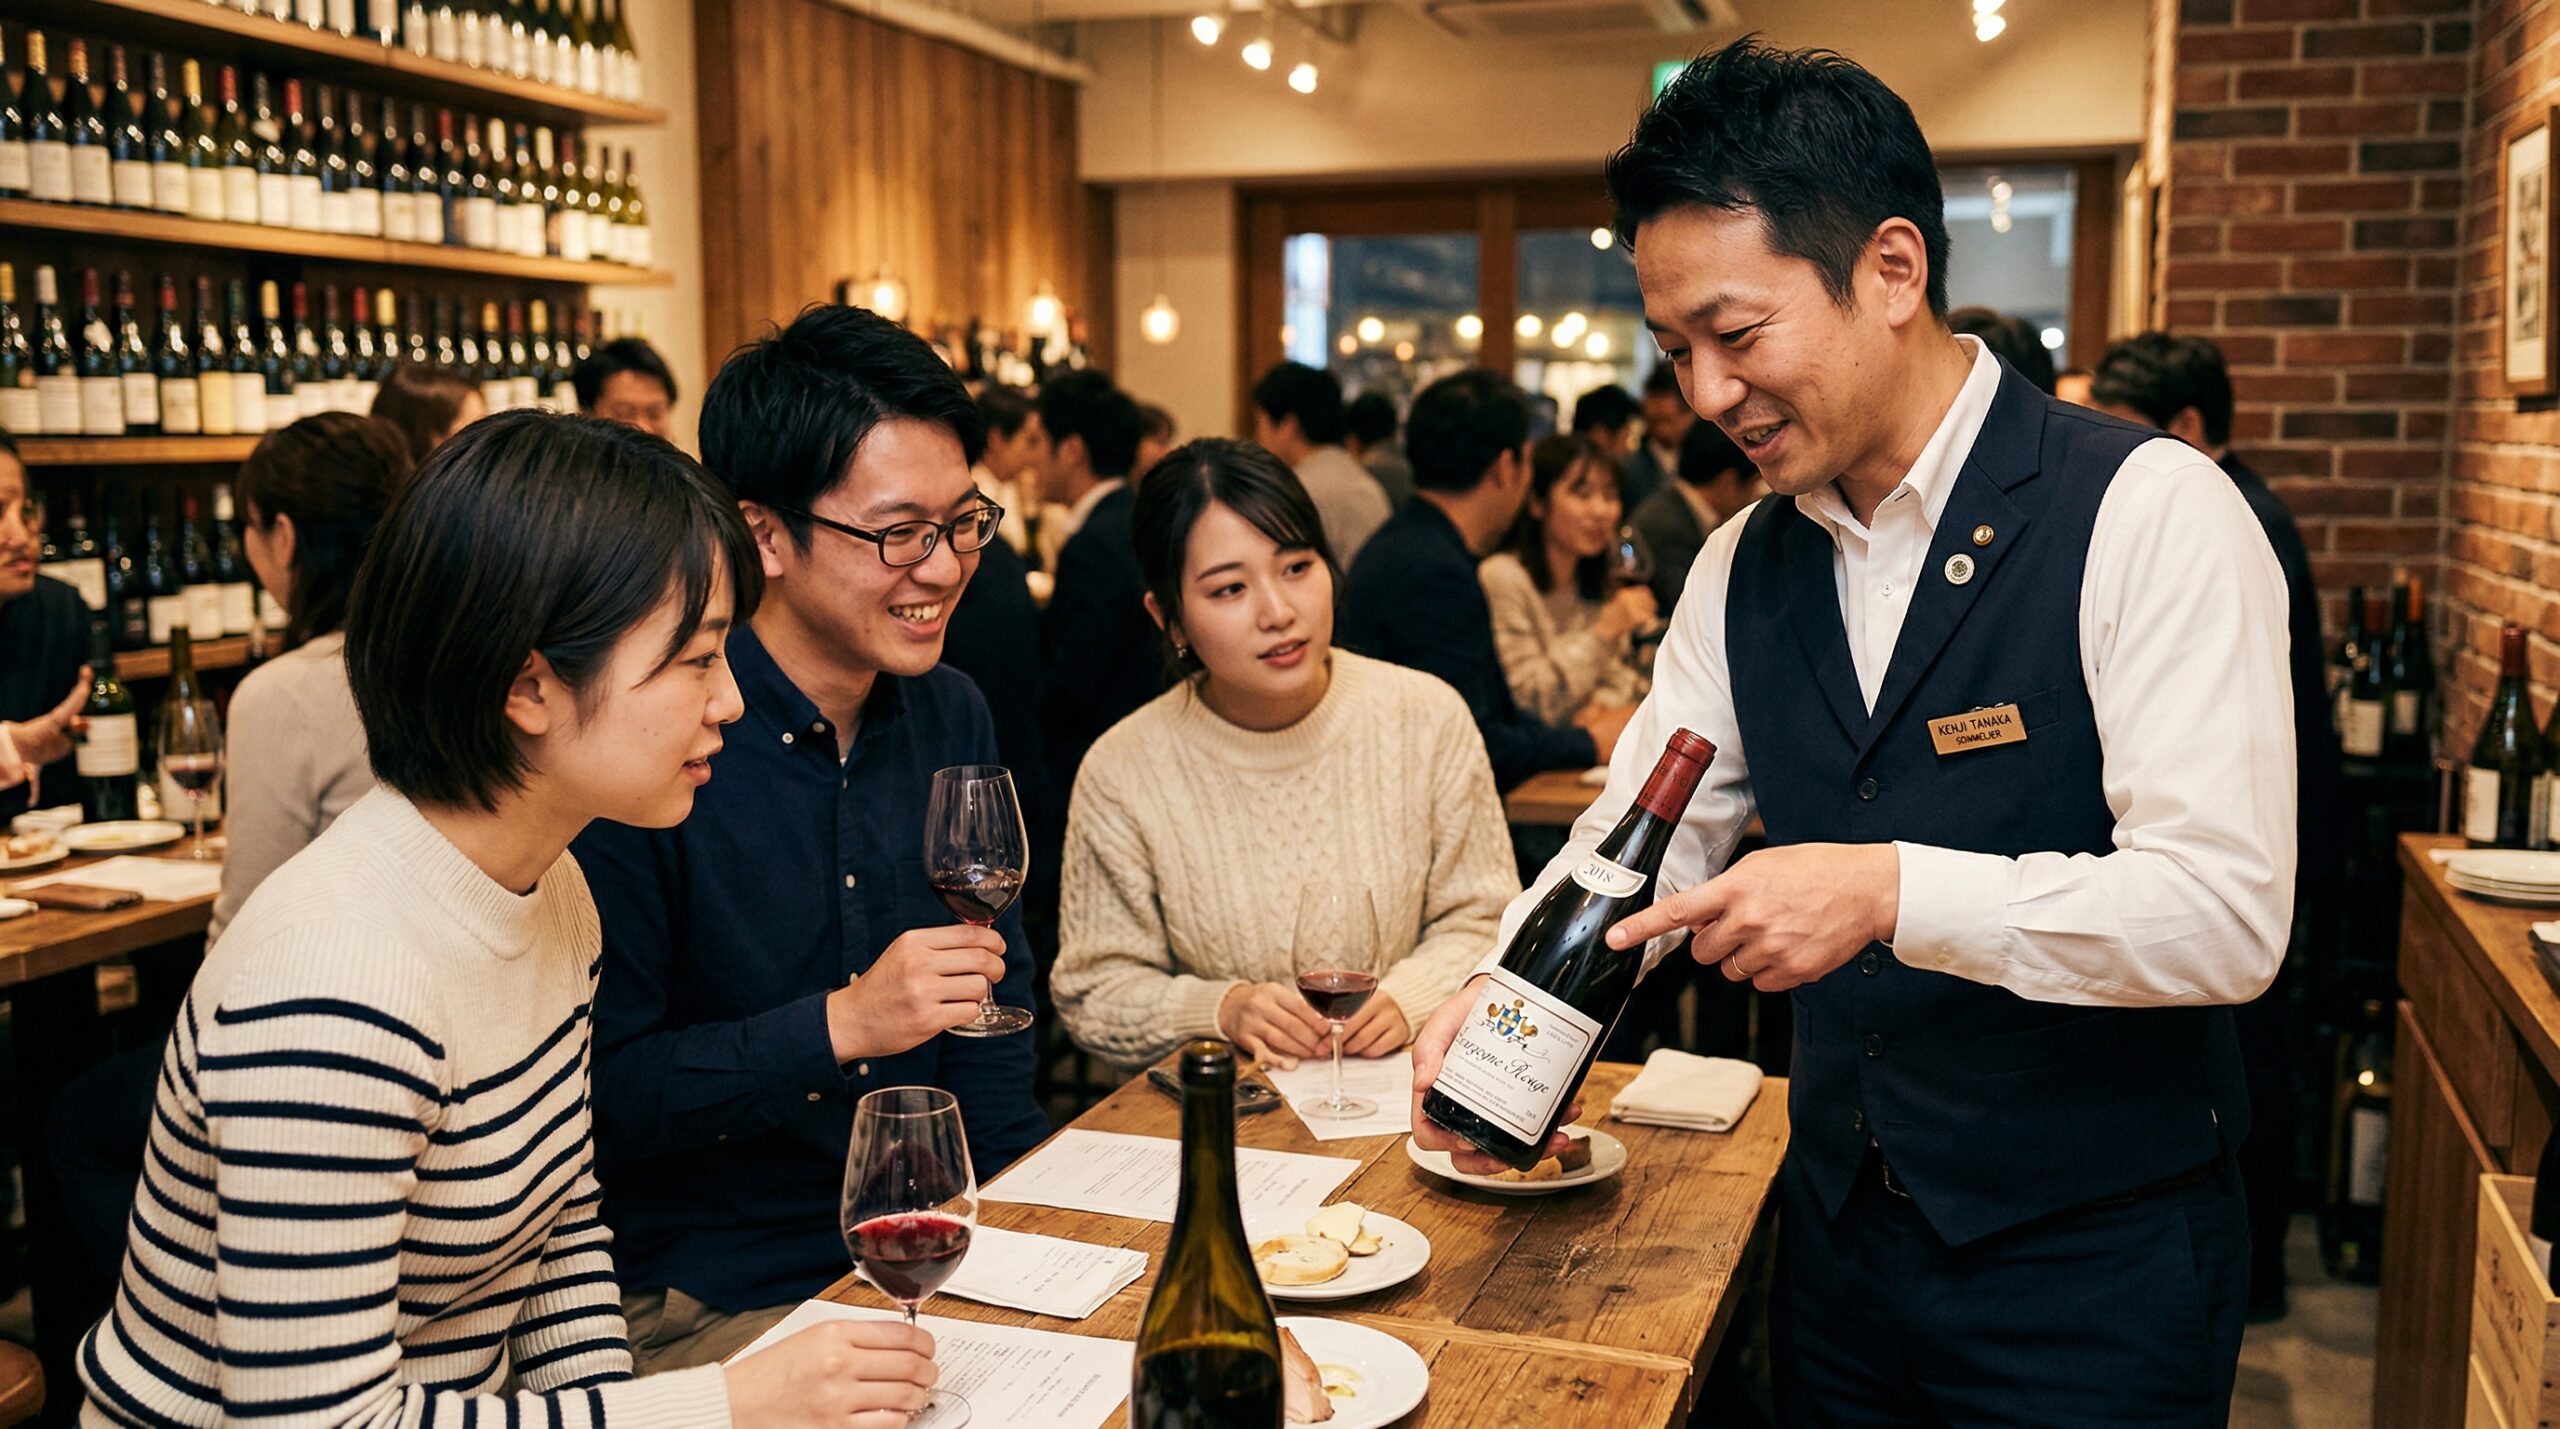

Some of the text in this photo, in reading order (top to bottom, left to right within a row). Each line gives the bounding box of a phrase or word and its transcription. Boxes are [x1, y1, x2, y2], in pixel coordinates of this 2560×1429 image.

[1938, 713, 2012, 736] KENJI TANAKA
[1583, 863, 1614, 883] 2018
[1504, 1058, 1550, 1094] Rouge
